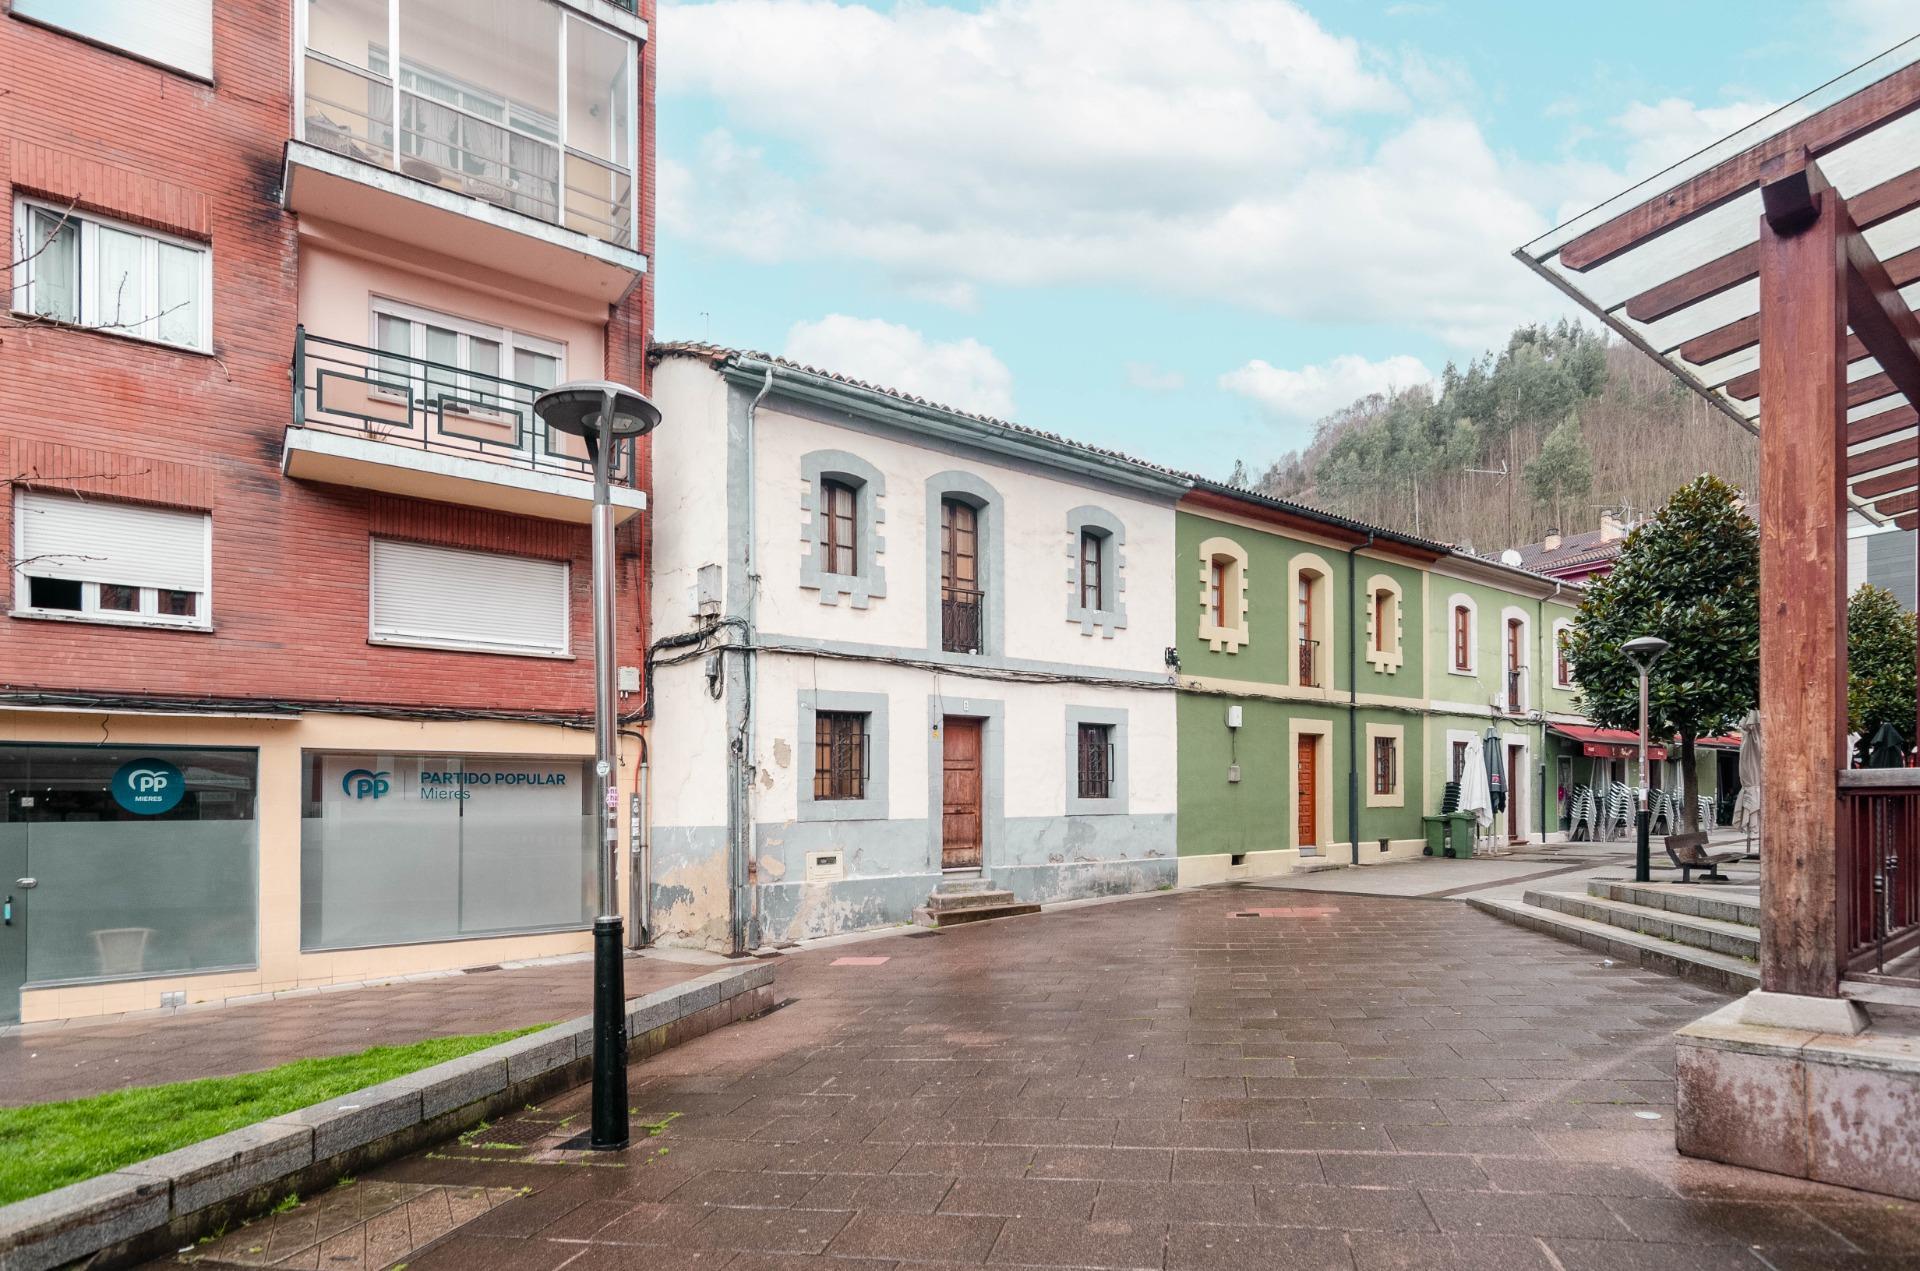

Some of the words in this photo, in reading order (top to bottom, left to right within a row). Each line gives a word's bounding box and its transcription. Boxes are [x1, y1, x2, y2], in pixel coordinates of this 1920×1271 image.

[420, 772, 492, 785] PARTIDO
[494, 773, 566, 785] POPULAR
[420, 787, 471, 800] Mieres
